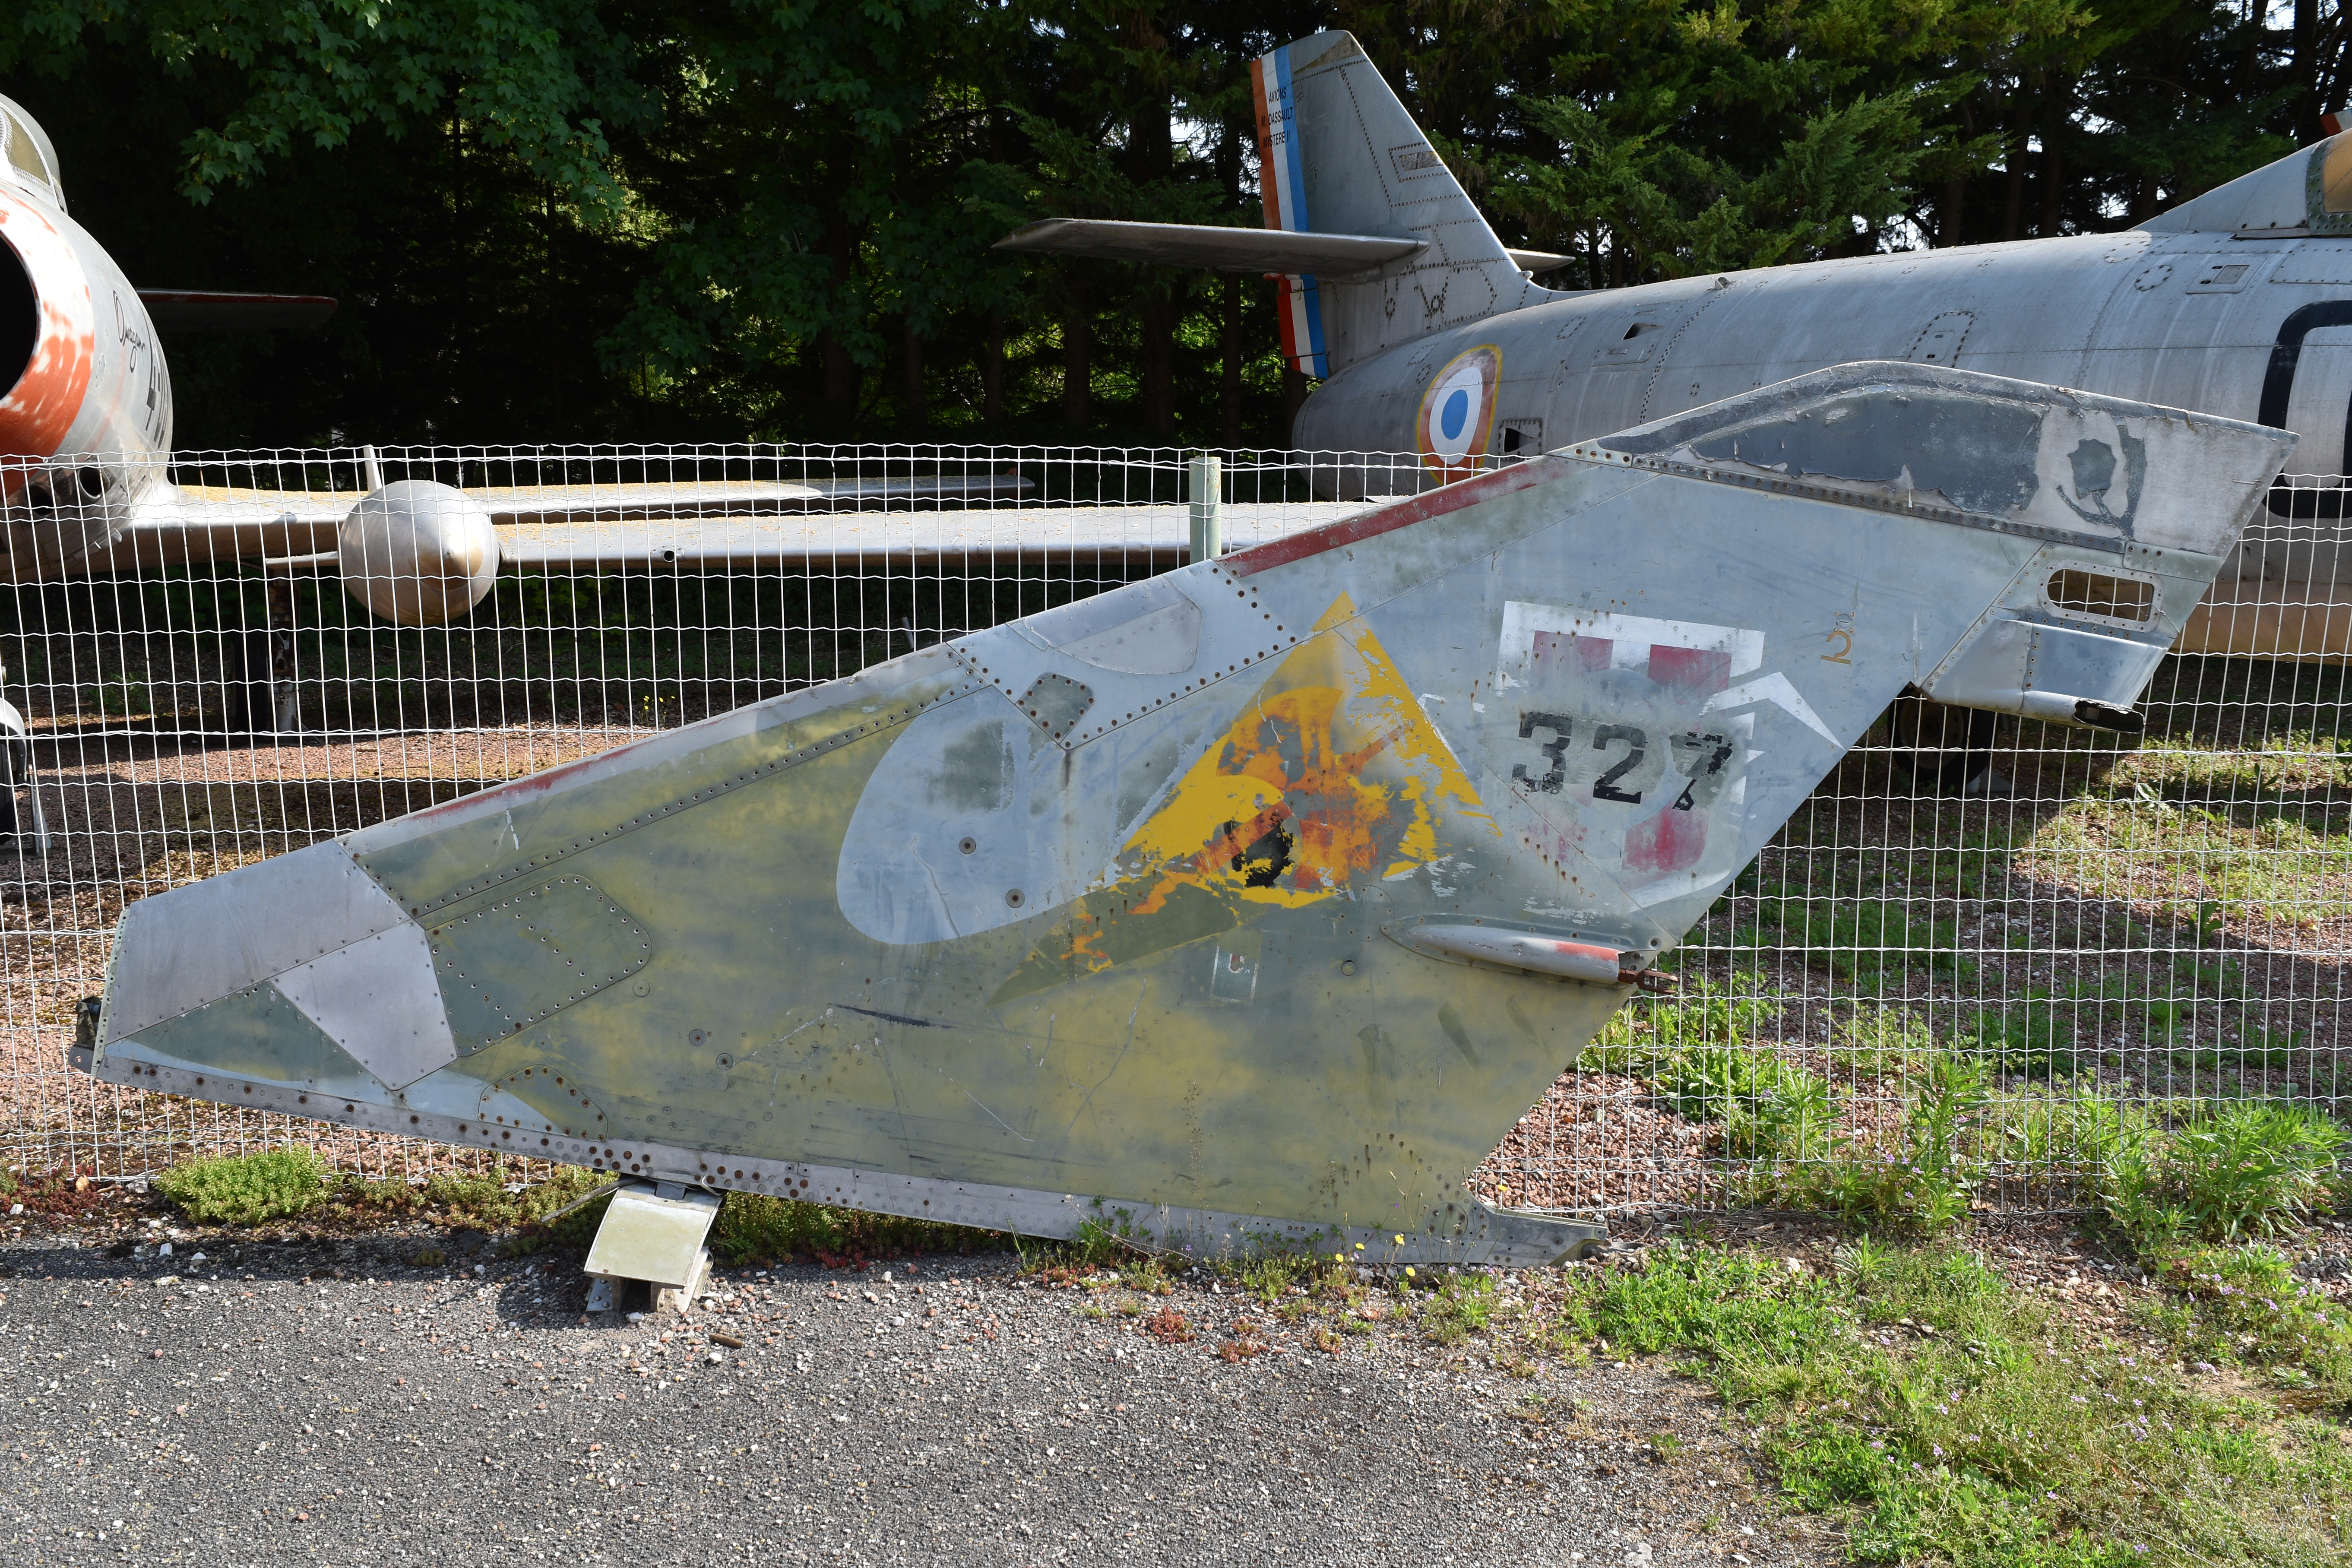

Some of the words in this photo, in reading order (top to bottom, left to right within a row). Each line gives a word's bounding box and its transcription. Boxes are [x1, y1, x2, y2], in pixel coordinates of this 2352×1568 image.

[1269, 87, 1286, 104] AVIONS
[1268, 107, 1293, 125] DASSAULT
[1263, 131, 1285, 148] MYSTERE
[1286, 130, 1290, 142] II
[1511, 711, 1733, 811] 327
